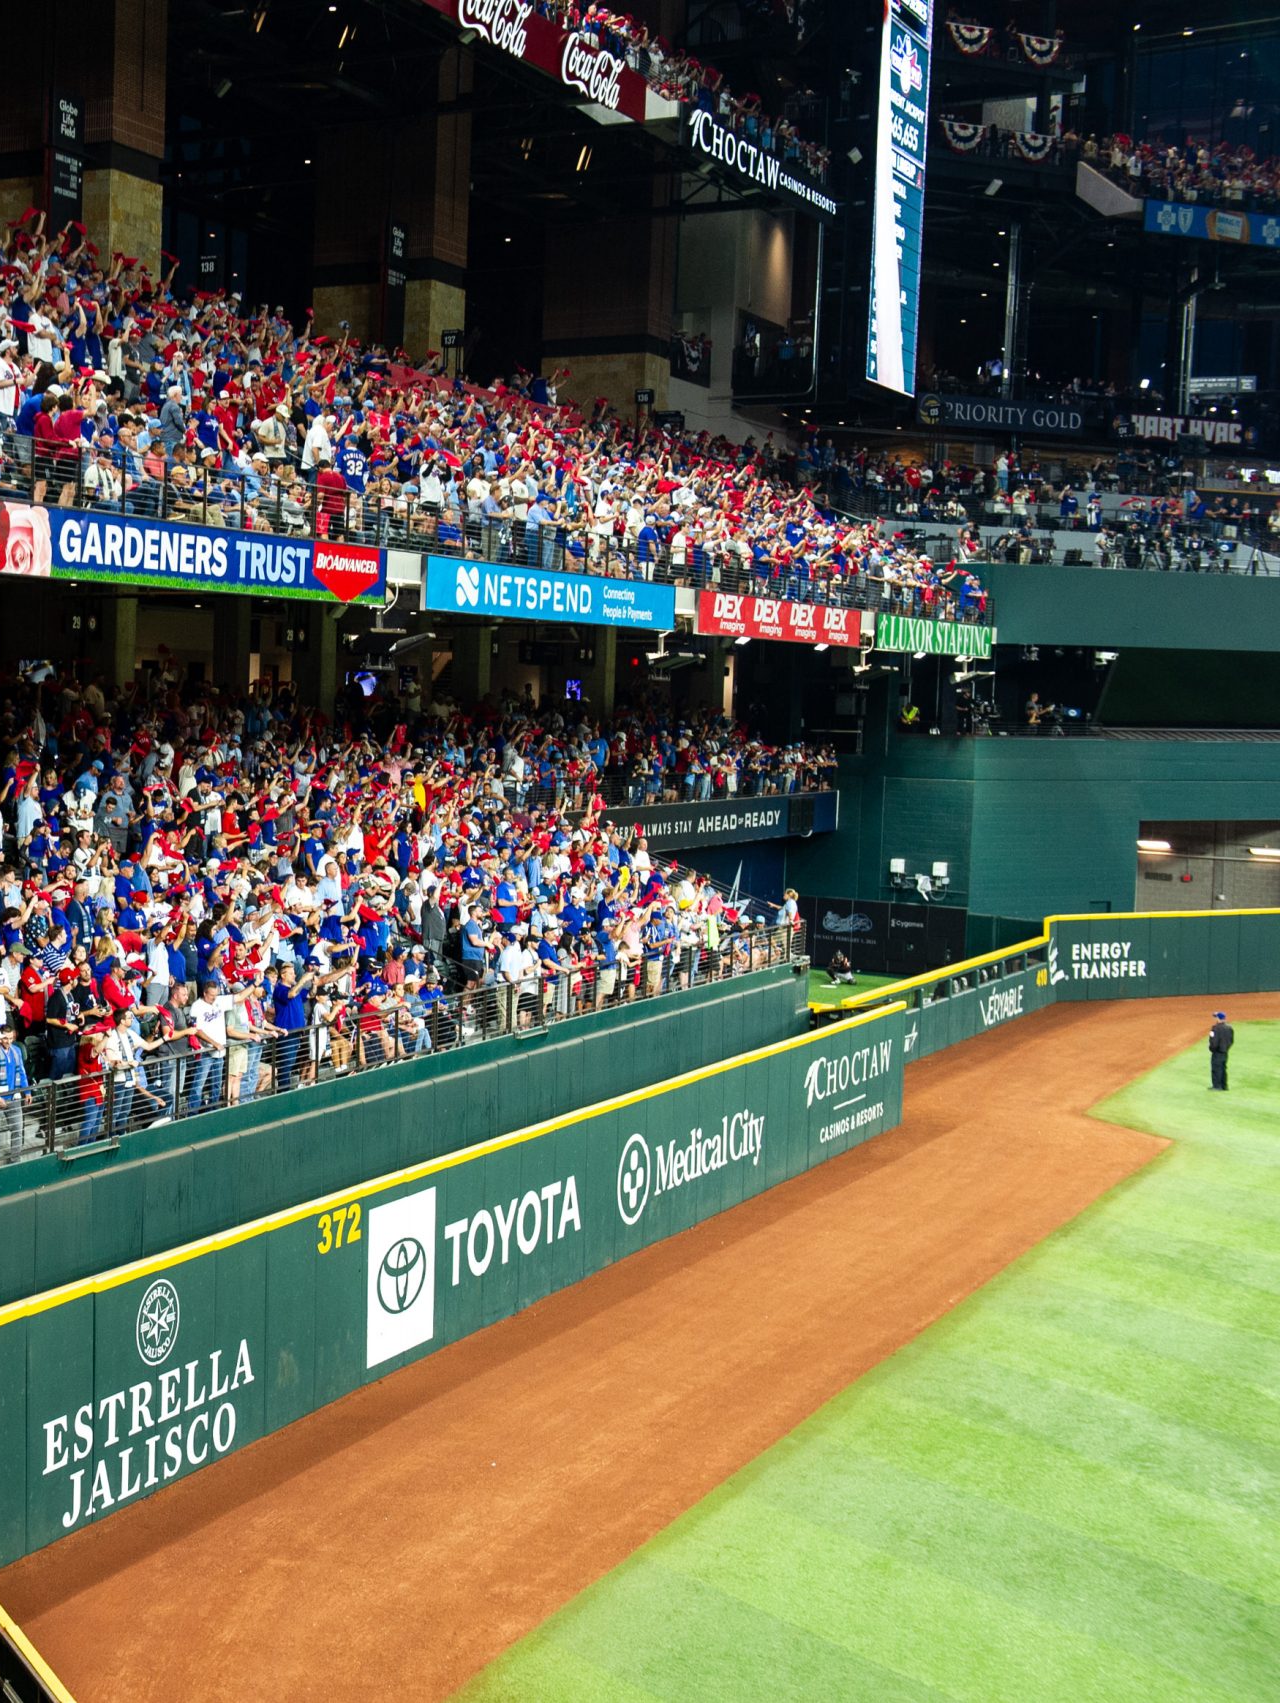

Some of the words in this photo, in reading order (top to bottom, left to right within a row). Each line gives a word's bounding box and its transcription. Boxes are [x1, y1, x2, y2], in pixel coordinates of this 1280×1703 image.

[561, 32, 626, 110] Coca-Cola
[59, 98, 78, 117] Globe
[62, 113, 74, 127] Life
[60, 125, 76, 140] Field
[699, 111, 780, 190] CHOCTAW
[779, 172, 806, 198] CASINOS
[806, 187, 811, 201] &
[811, 190, 837, 215] RESORTS
[200, 262, 214, 273] 138
[444, 336, 456, 347] 137
[1032, 409, 1082, 430] GOLD
[346, 461, 364, 475] 32
[58, 519, 228, 578] GARDENERS
[236, 541, 310, 584] TRUST
[484, 574, 592, 614] NETSPEND
[603, 585, 635, 604] Connecting
[603, 603, 621, 620] People
[627, 606, 652, 623] Payments
[713, 592, 745, 620] DEX
[753, 598, 782, 624] DEX
[789, 603, 816, 628] DEX
[720, 618, 745, 634] imaging
[759, 622, 782, 637] imaging
[823, 608, 848, 631] DEX
[794, 626, 816, 640] imaging
[828, 630, 849, 643] imaging
[889, 615, 934, 653] LUXOR
[934, 621, 991, 657] STAFFING
[642, 822, 672, 838] ALWAYS
[674, 820, 693, 834] STAY
[697, 813, 738, 834] AHEAD
[744, 810, 781, 829] READY
[1072, 942, 1131, 961] ENERGY
[1036, 968, 1048, 987] 410
[1072, 960, 1147, 979] TRANSFER
[814, 1039, 893, 1101] CHOCTAW
[819, 1119, 850, 1144] CASINOS
[850, 1119, 856, 1131] &
[856, 1102, 884, 1126] RESORTS
[654, 1116, 728, 1197] Medical
[730, 1108, 765, 1166] City
[317, 1203, 362, 1255] 372
[445, 1175, 582, 1286] TOYOTA
[142, 1286, 175, 1316] ESTRELLA
[144, 1336, 172, 1359] JALISCO
[42, 1338, 255, 1476] ESTRELLA
[61, 1402, 236, 1528] JALISCO
